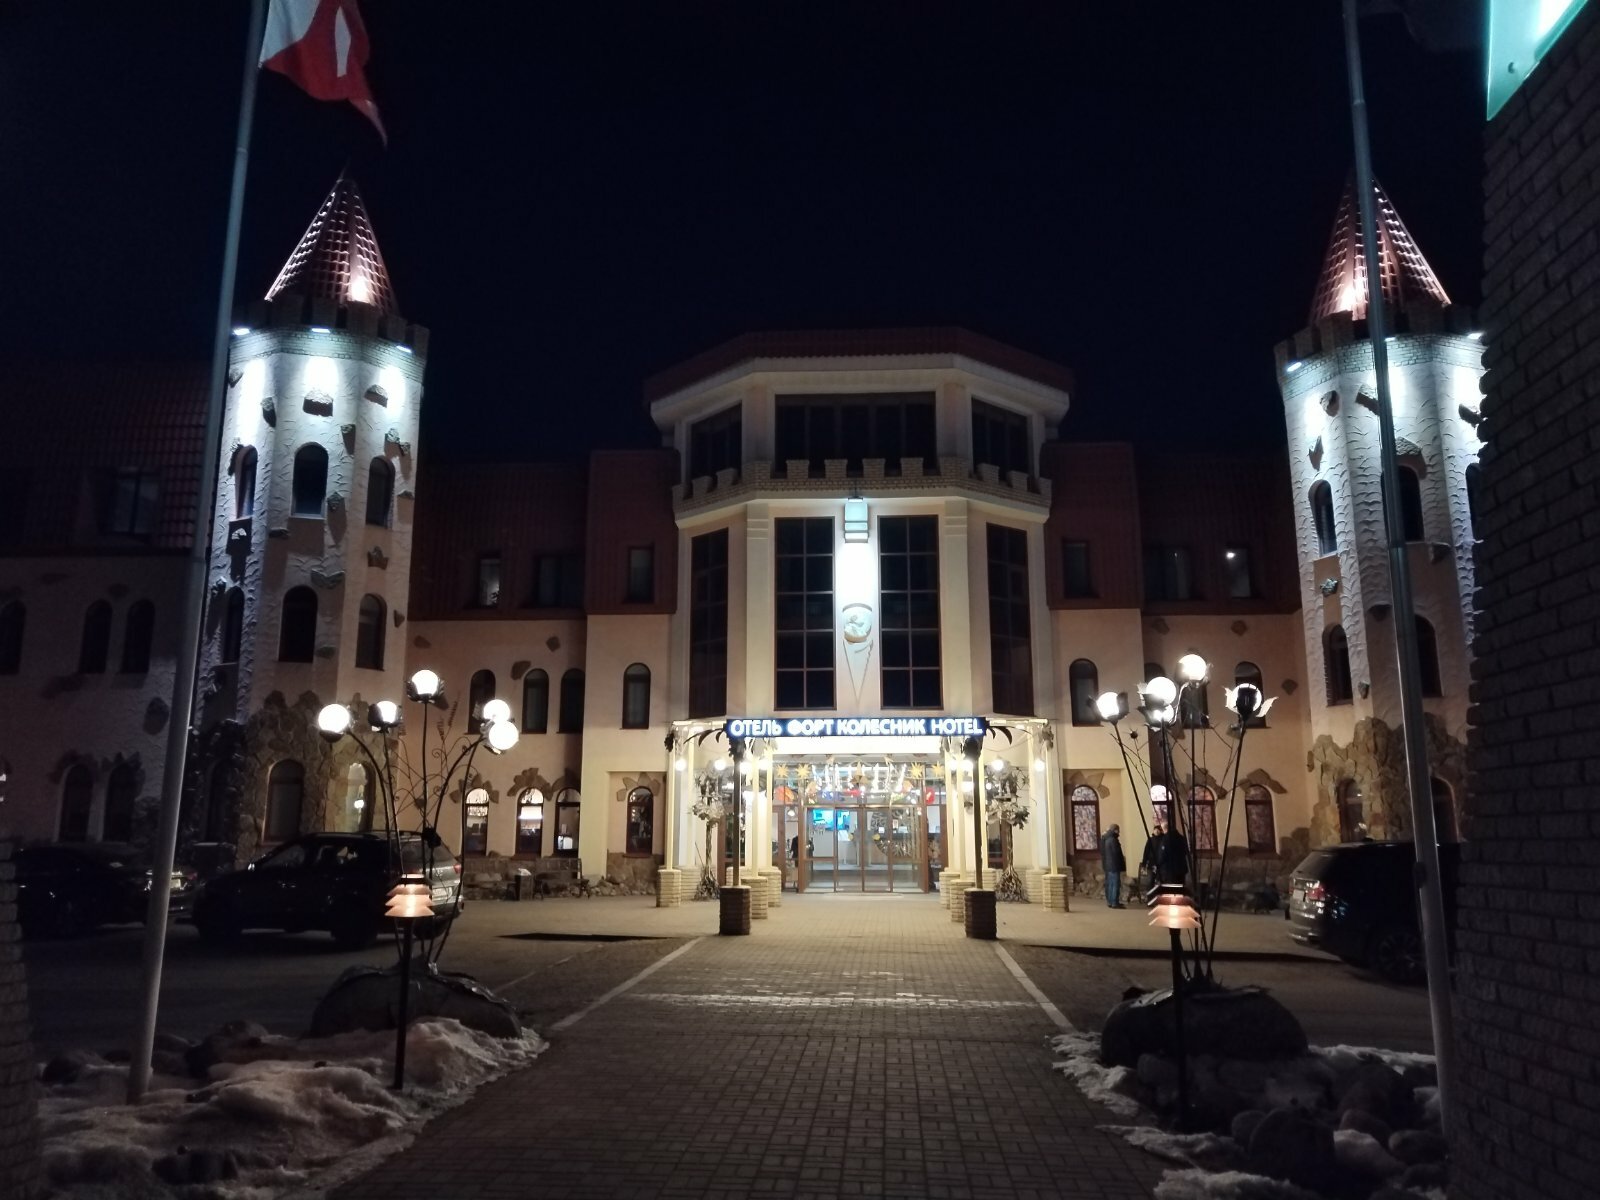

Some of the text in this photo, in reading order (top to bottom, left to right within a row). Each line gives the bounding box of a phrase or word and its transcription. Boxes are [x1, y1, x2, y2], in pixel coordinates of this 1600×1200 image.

[731, 718, 983, 736] ОТЕЛЬ ФОРТ КОЛЕСНИК HOTEL
